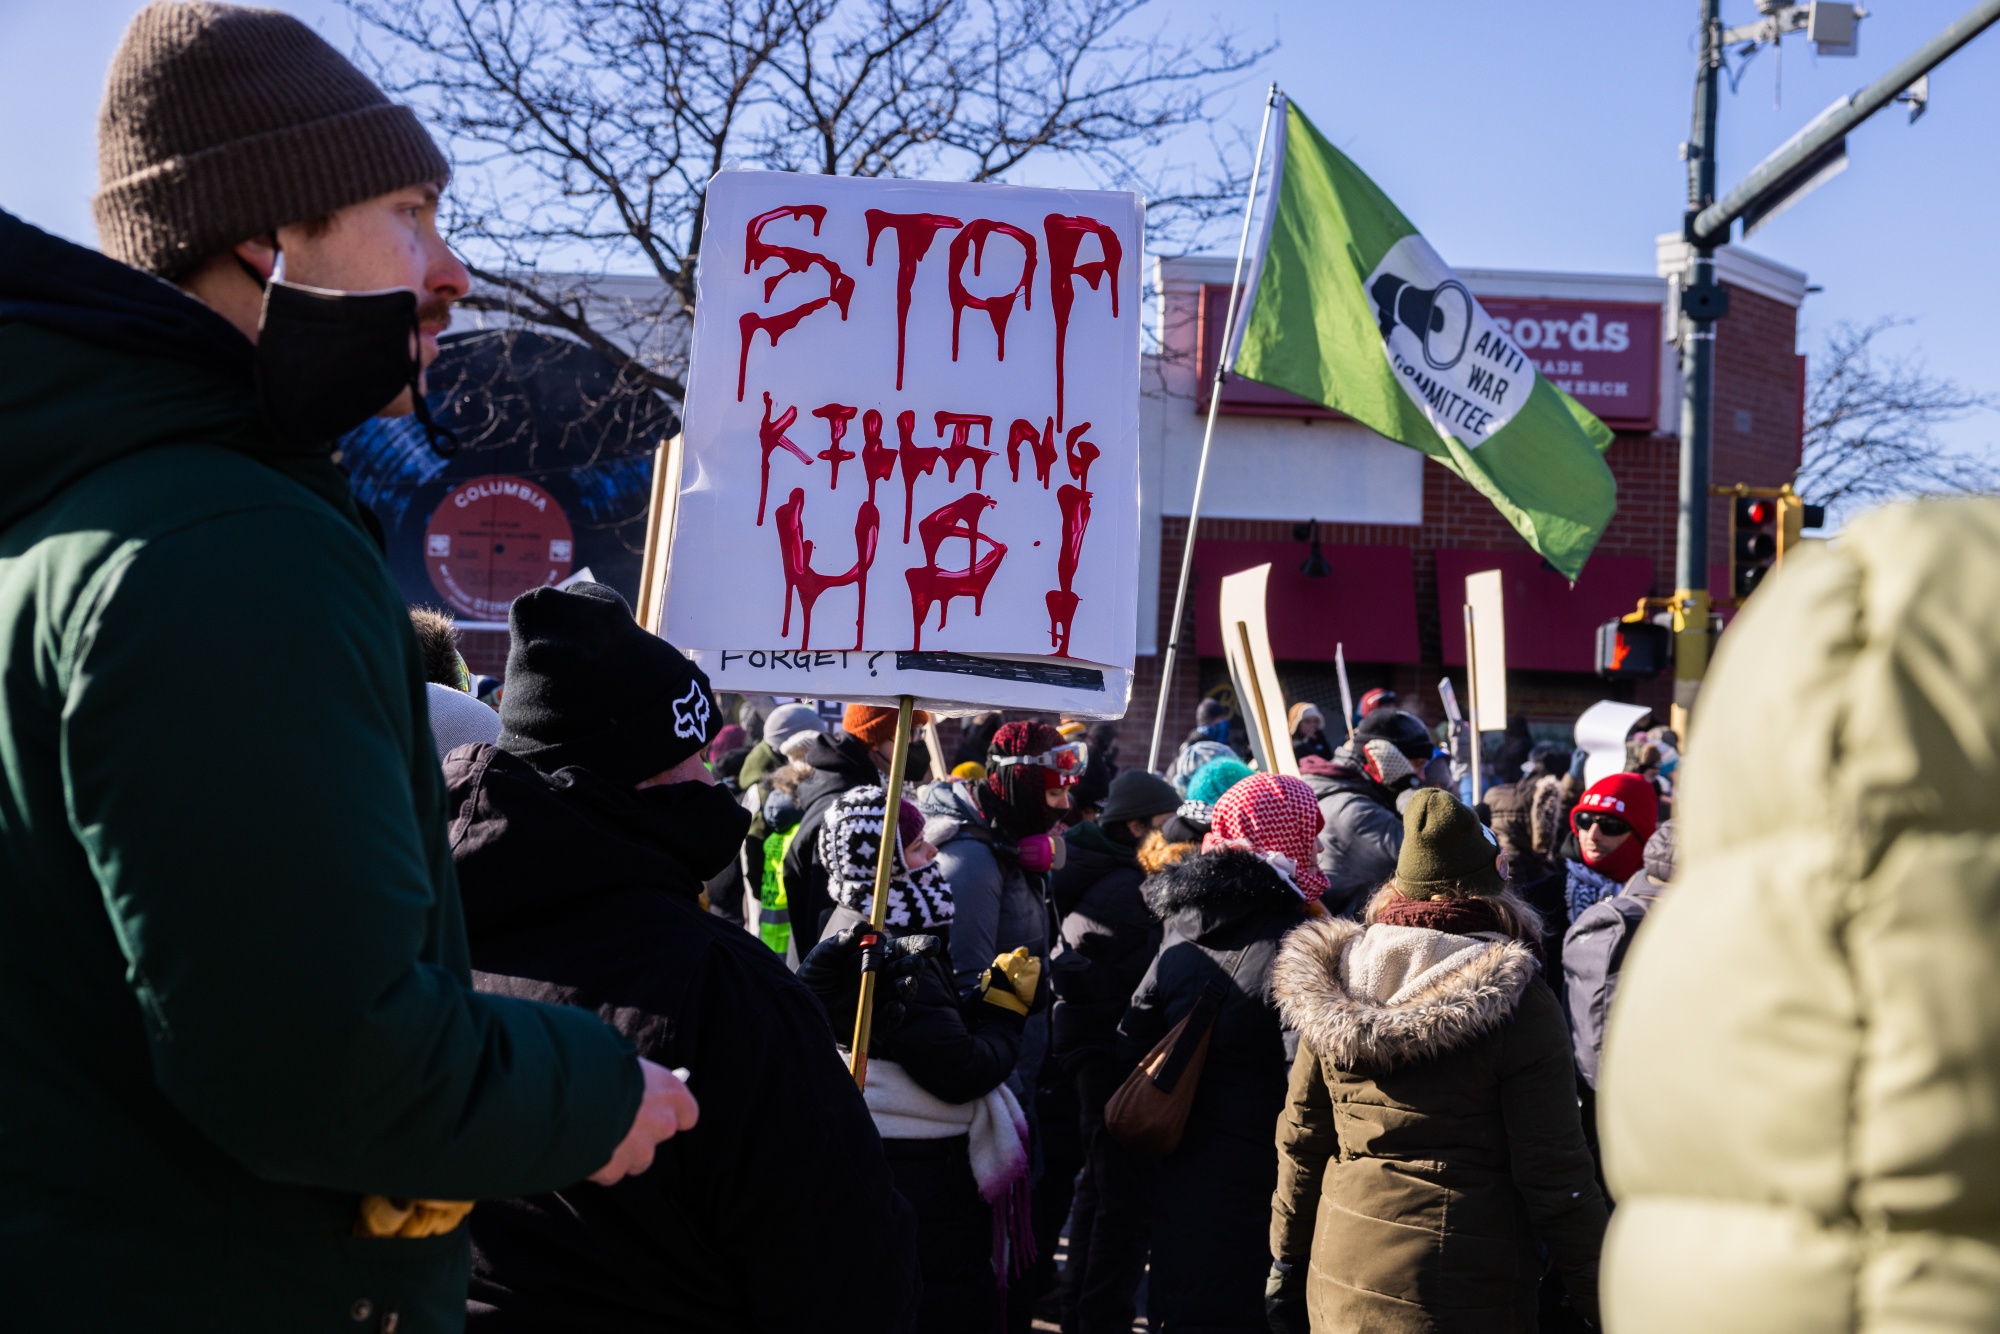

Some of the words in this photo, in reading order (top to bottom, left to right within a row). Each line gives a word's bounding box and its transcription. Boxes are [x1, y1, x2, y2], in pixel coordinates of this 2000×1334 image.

[738, 204, 1123, 432] STOP
[1474, 331, 1525, 374] ANTI
[1467, 363, 1509, 405] WAR
[757, 391, 1101, 543] KILLING
[454, 481, 548, 512] COLUMBIA
